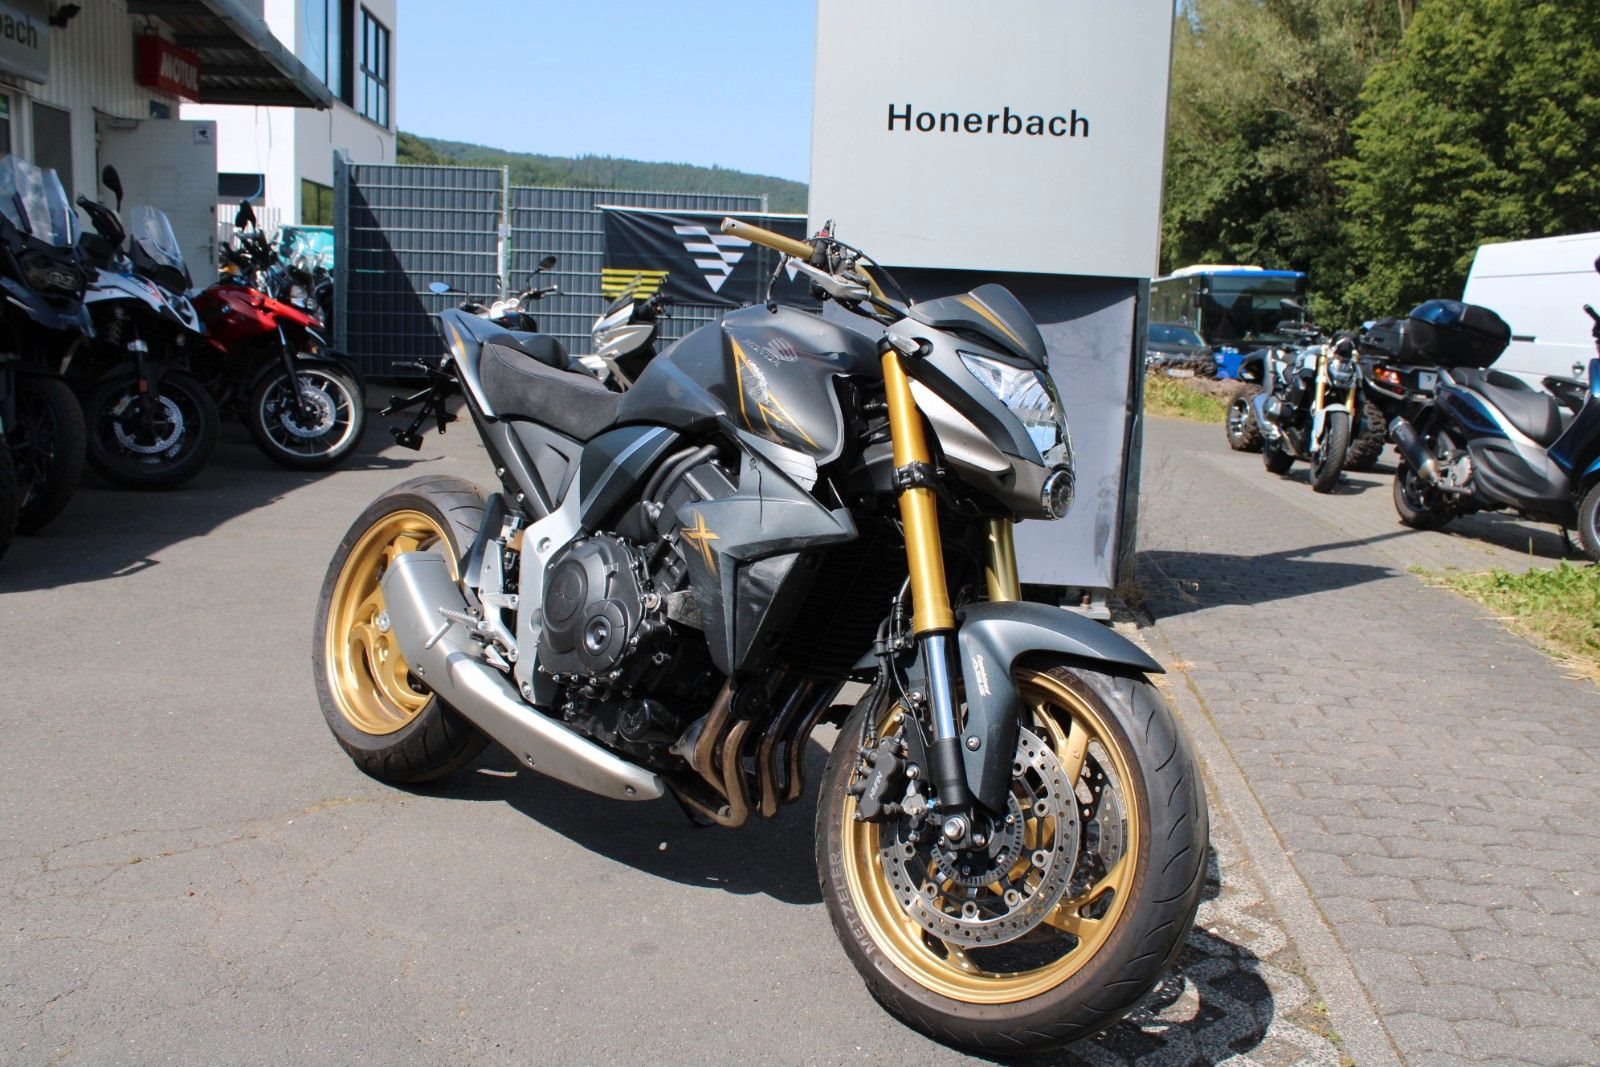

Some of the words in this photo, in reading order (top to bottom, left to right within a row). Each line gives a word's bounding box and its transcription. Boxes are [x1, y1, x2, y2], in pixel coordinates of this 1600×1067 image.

[0, 13, 38, 50] ach
[161, 51, 199, 91] MOTUL
[888, 104, 1089, 137] Honerbach
[830, 853, 876, 955] METZELER
